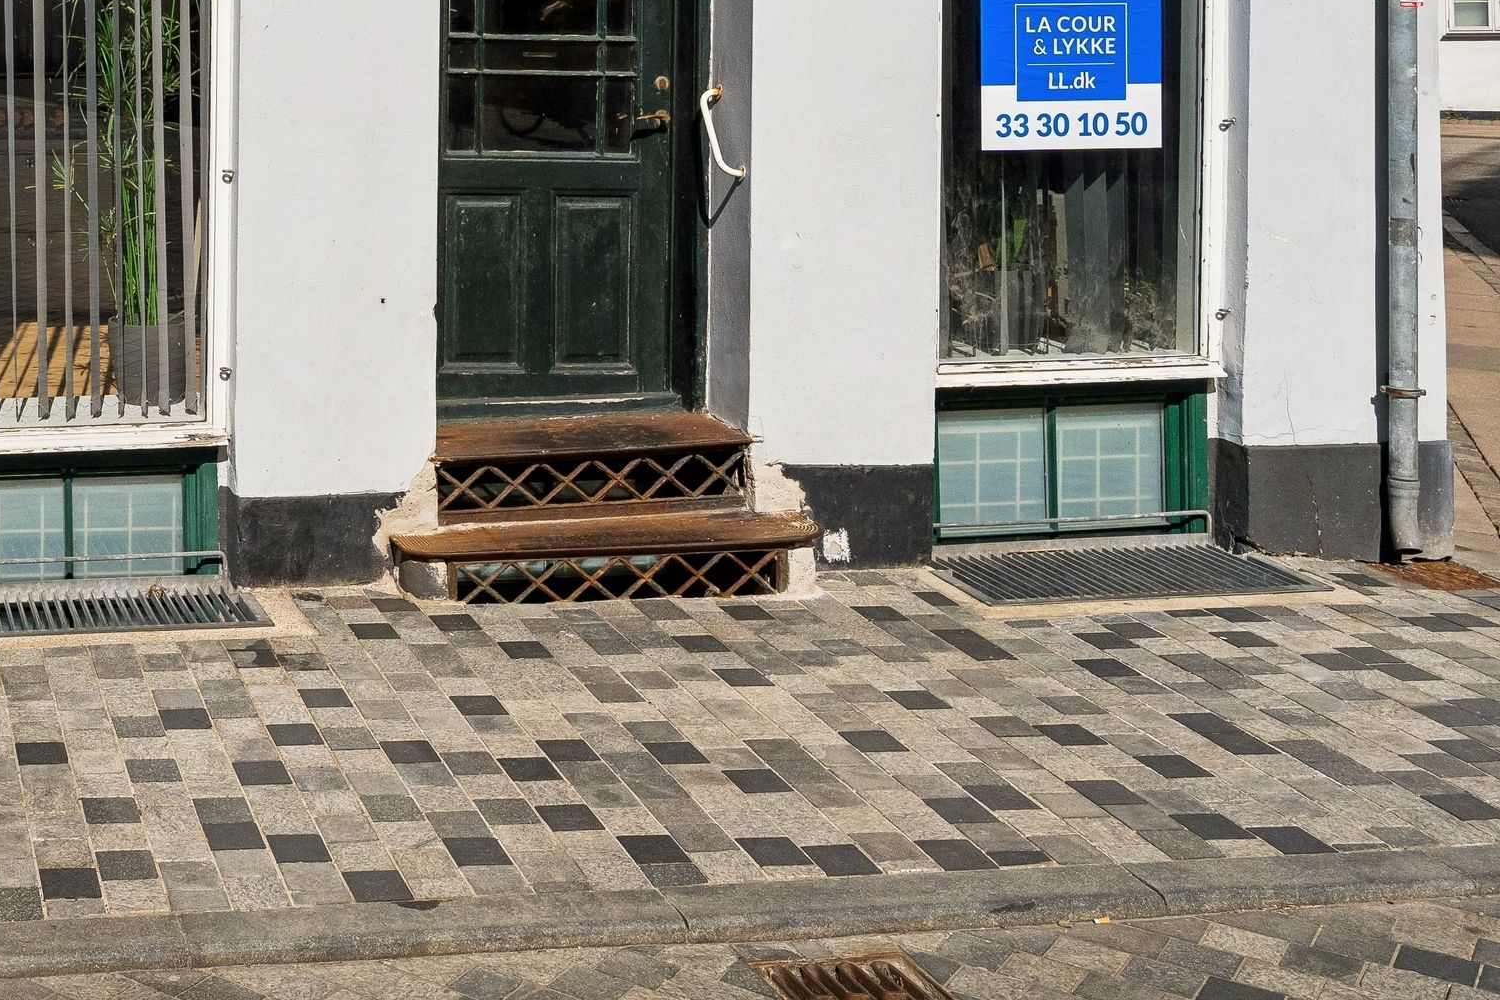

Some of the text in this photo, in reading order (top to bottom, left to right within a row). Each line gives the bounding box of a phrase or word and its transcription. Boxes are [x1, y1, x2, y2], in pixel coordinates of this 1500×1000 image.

[1026, 16, 1115, 32] LA COUR
[1034, 38, 1115, 54] & LYKKE
[1049, 72, 1095, 89] LL.dk
[996, 112, 1147, 137] 33 30 10 50
